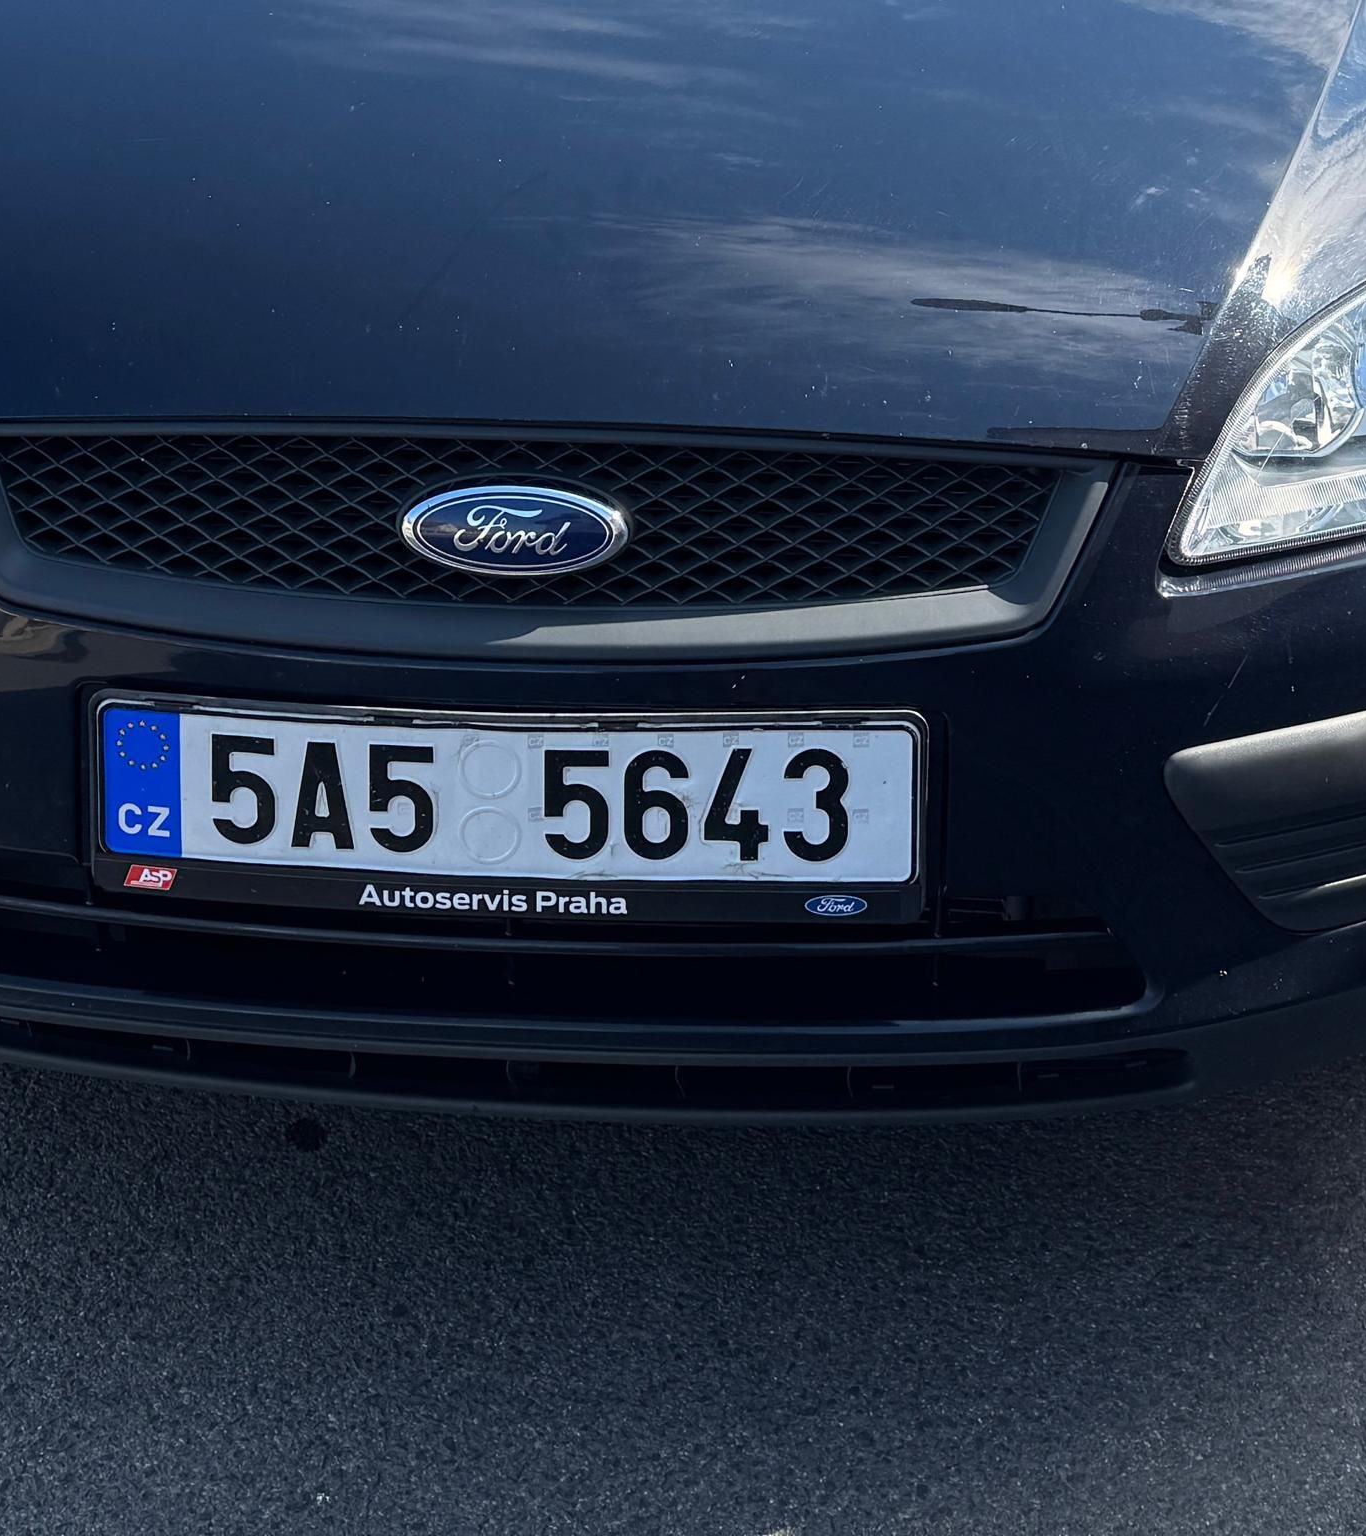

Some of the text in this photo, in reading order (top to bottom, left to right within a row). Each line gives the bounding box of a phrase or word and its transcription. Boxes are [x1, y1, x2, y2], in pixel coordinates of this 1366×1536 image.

[453, 504, 571, 556] Ford
[211, 733, 849, 862] 5A5 5643
[118, 802, 170, 838] CZ
[138, 868, 173, 888] ASP
[358, 883, 628, 914] Autoservis Praha
[816, 897, 855, 913] Ford
